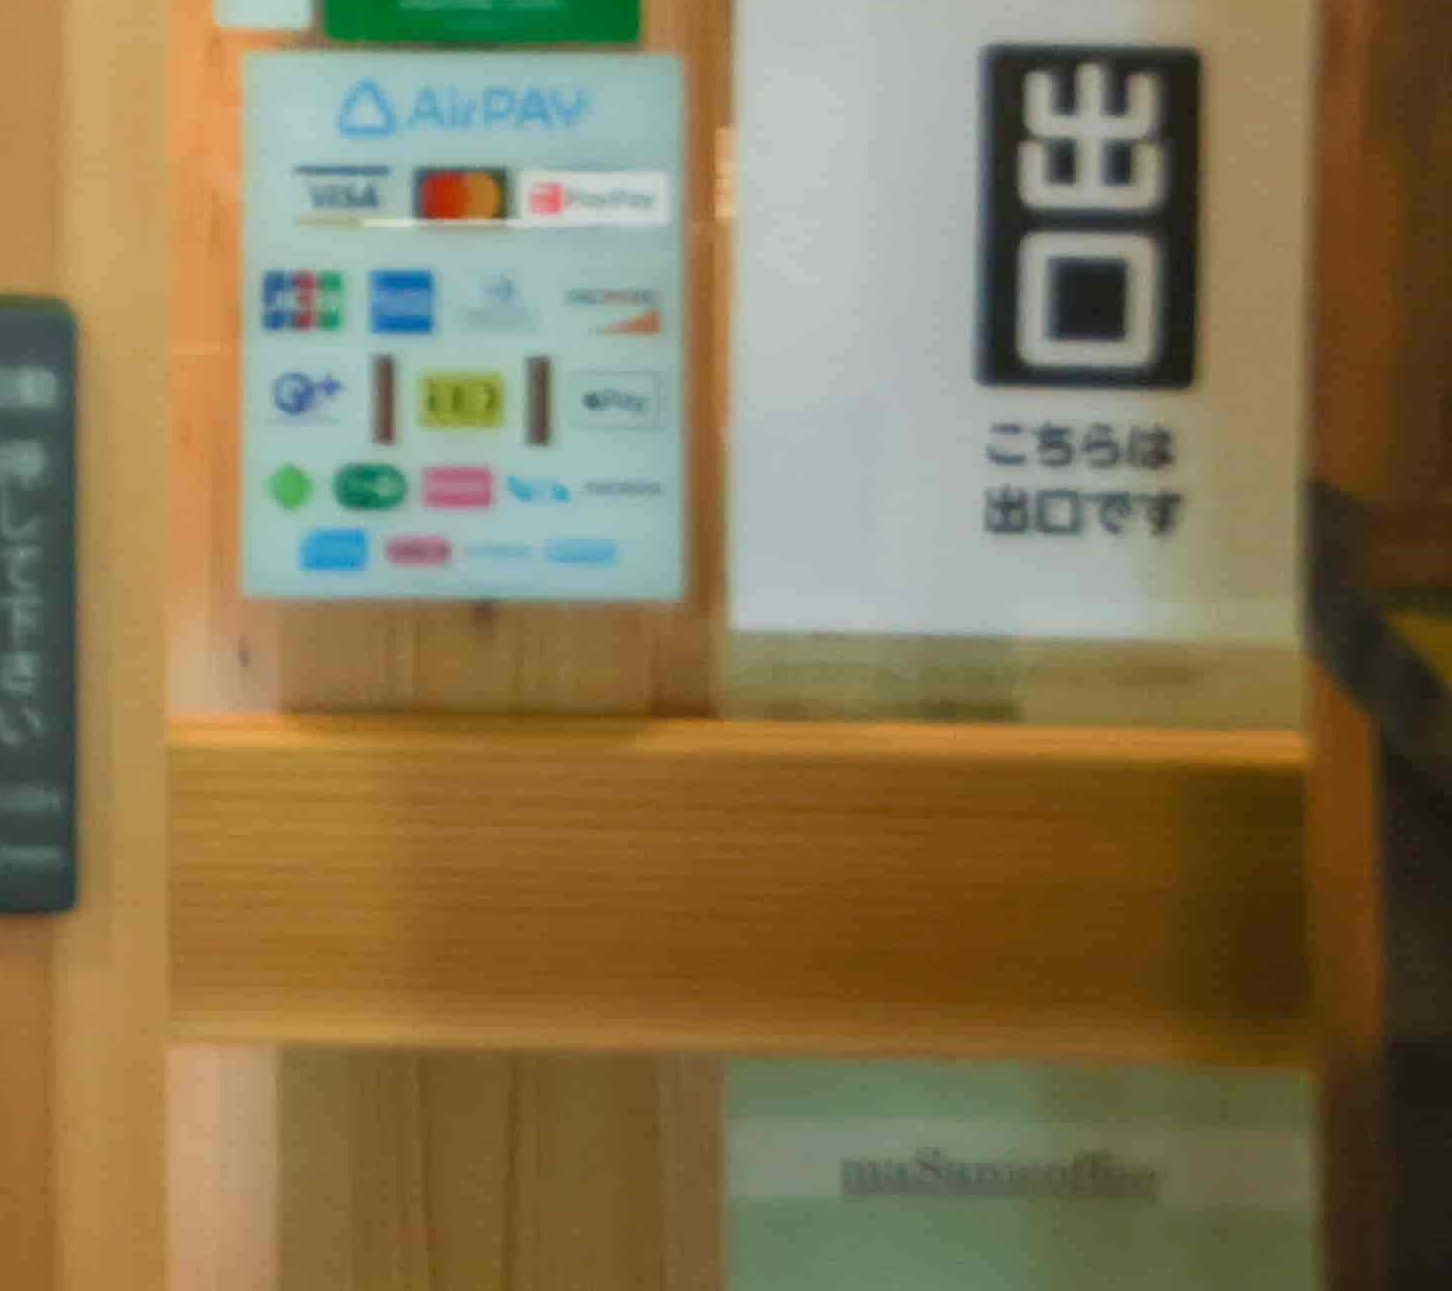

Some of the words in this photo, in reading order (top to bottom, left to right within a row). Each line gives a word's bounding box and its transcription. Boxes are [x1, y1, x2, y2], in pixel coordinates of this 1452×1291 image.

[1015, 62, 1169, 369] 出口
[985, 422, 1175, 470] こちらは
[984, 486, 1181, 536] 出口です
